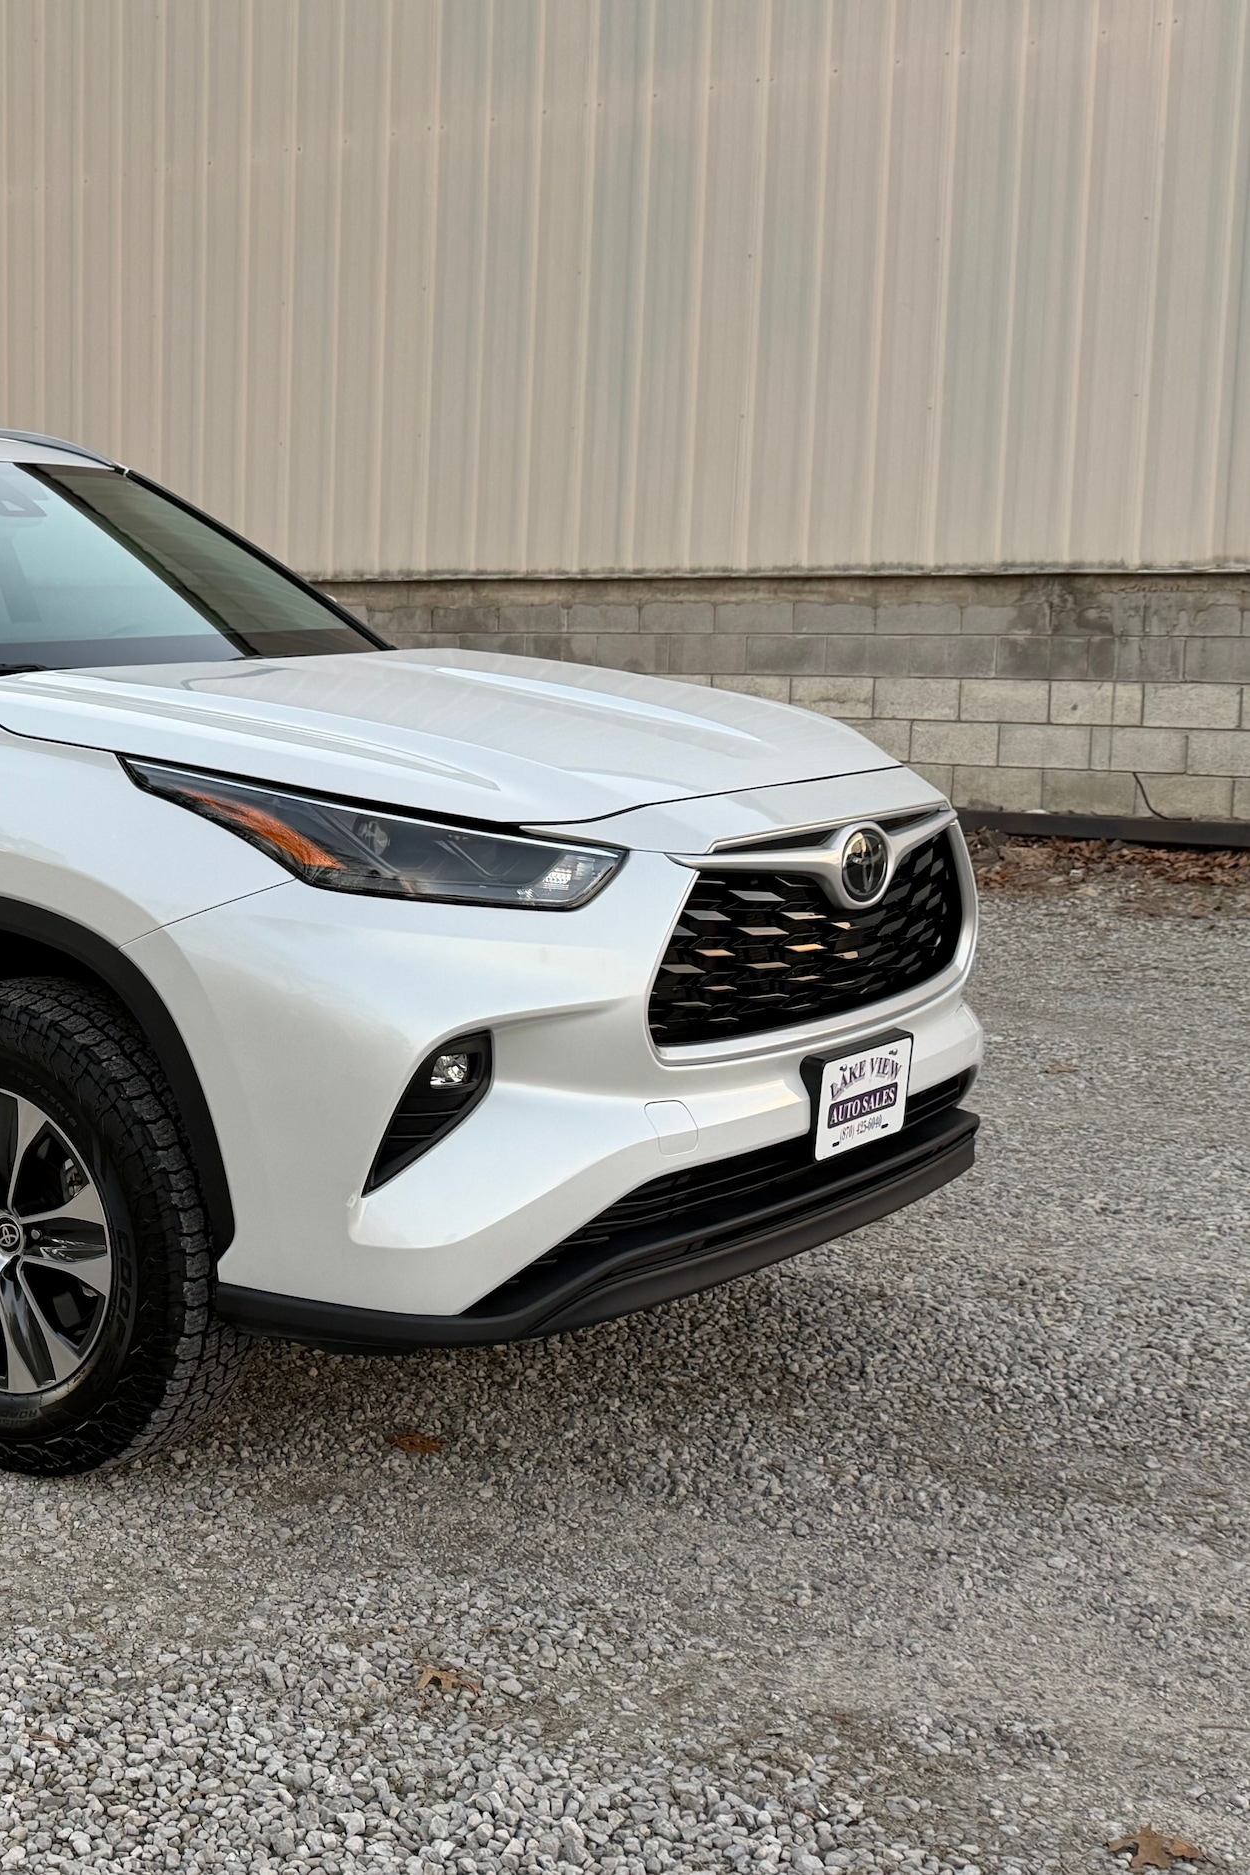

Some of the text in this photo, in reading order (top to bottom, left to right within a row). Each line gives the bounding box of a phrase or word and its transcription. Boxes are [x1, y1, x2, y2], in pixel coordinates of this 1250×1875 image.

[830, 1057, 902, 1100] LAKE VIEW
[830, 1086, 895, 1124] AUTO SALES
[839, 1114, 883, 1142] (870) 425-6040
